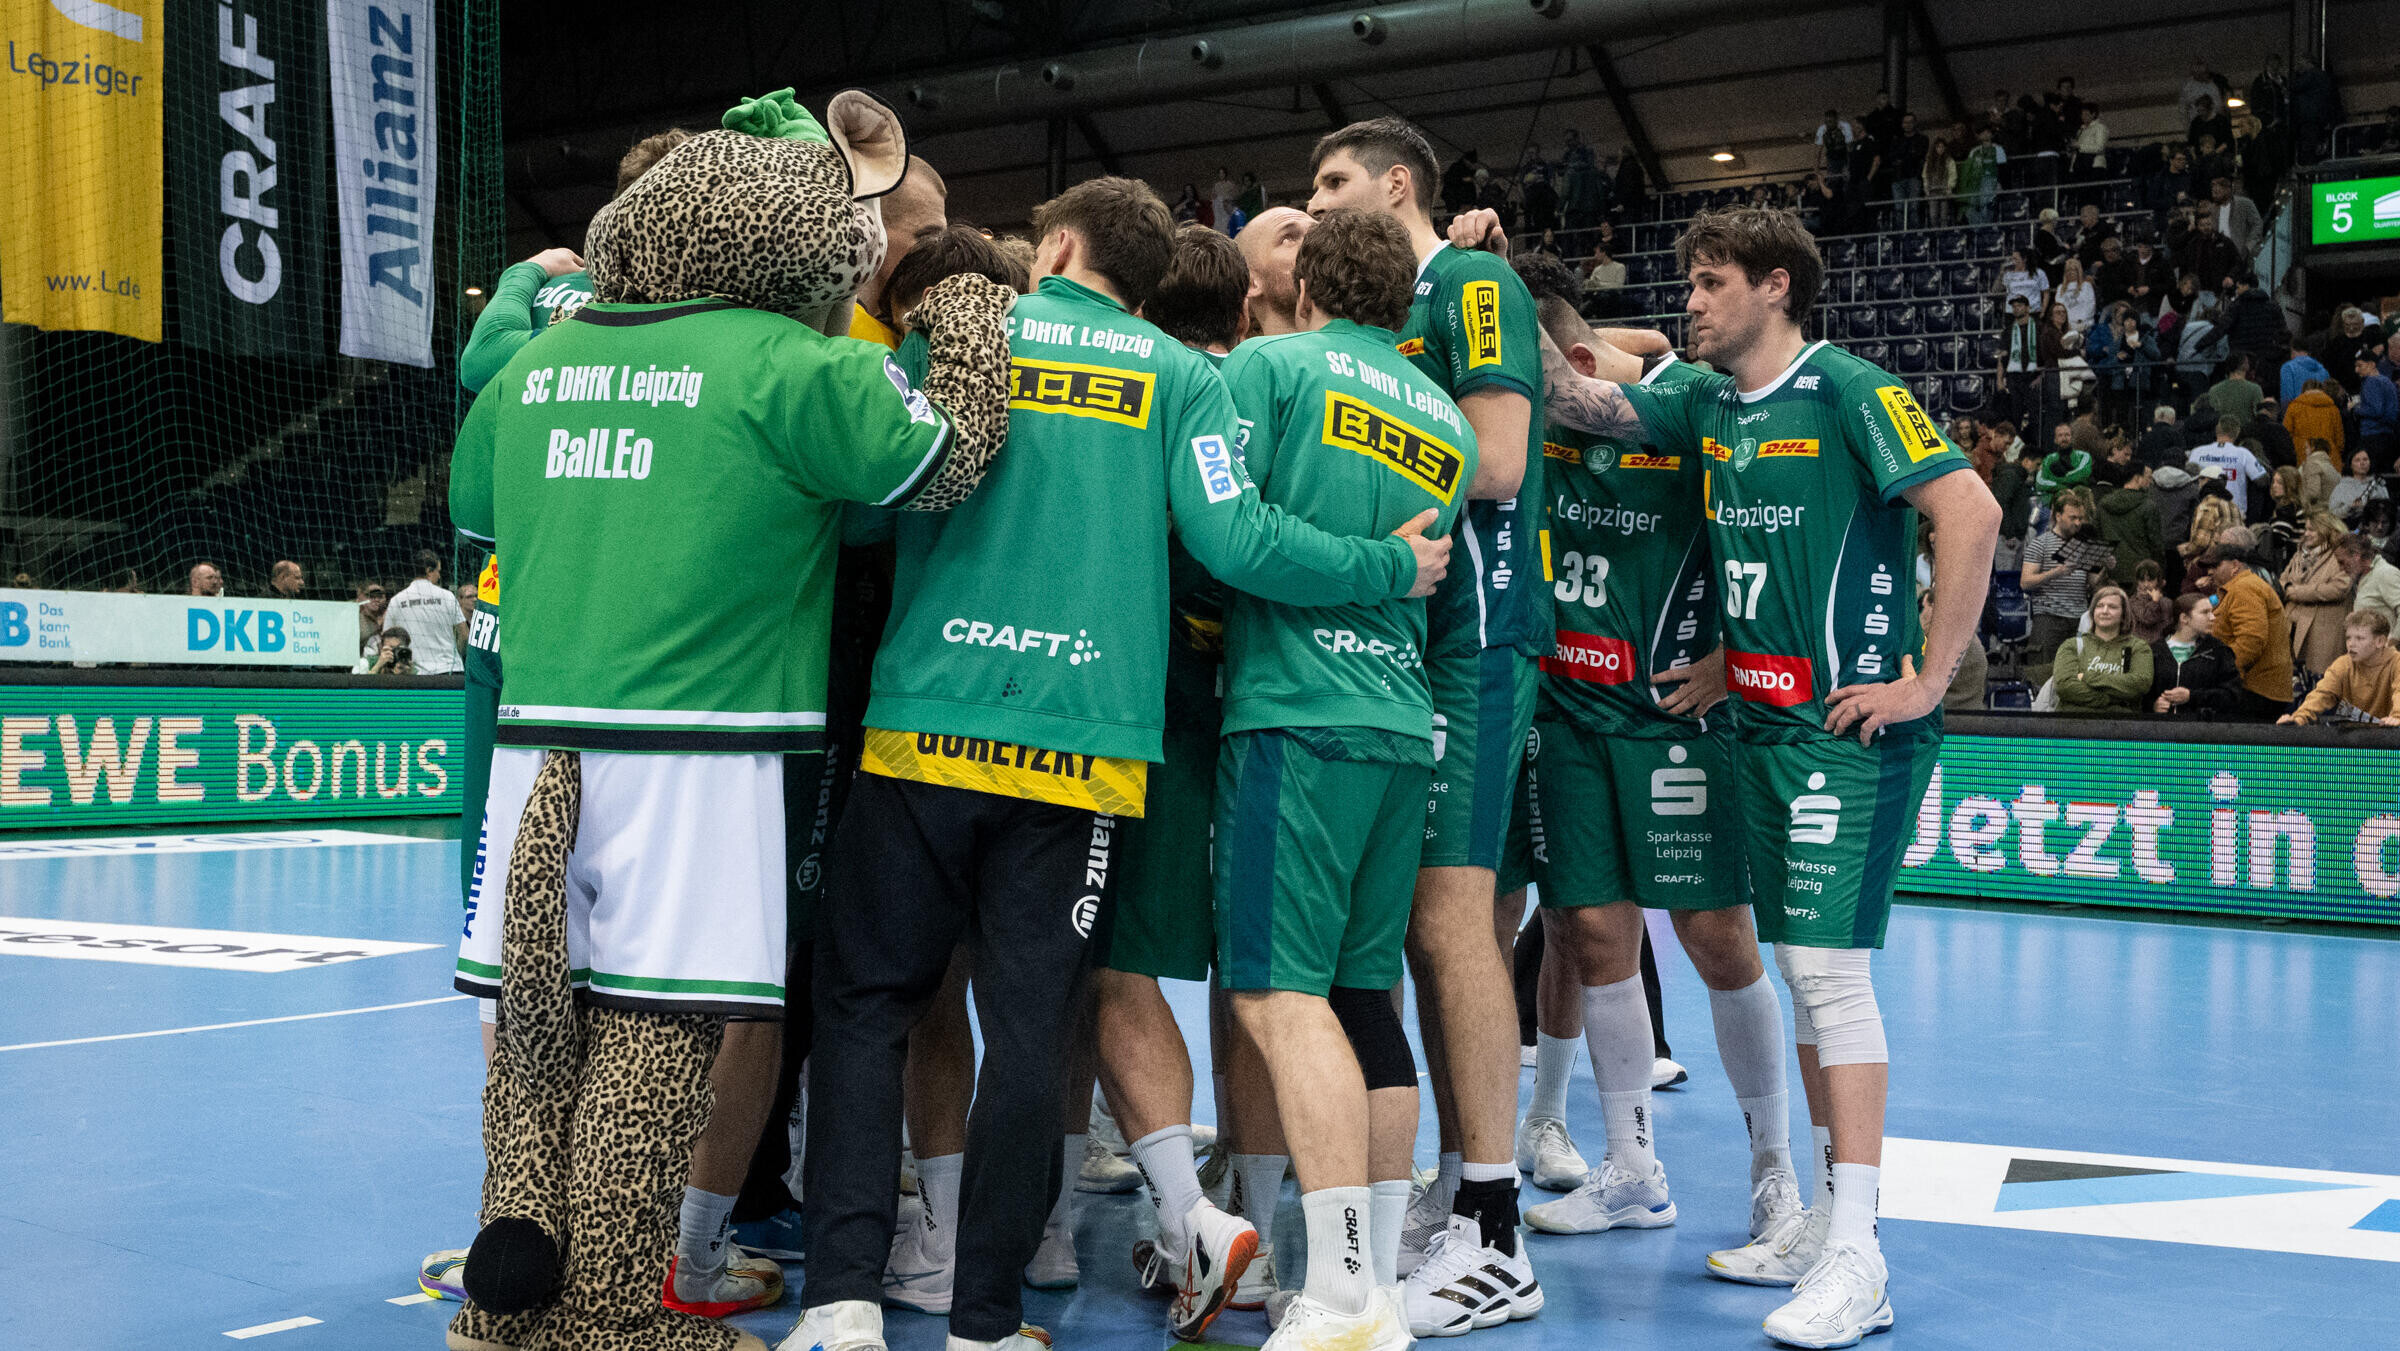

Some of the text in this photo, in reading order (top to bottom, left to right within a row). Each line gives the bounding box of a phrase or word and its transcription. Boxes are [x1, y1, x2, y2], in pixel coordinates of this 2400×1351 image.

[219, 0, 282, 304] CRAF
[363, 5, 424, 308] Allianz
[2326, 191, 2358, 203] BLOCK
[2332, 202, 2353, 233] 5
[1005, 316, 1155, 359] C DHfK Leipzig
[1477, 289, 1496, 356] B.A.S.
[521, 364, 704, 409] SC DHfK Leipzig
[1325, 350, 1462, 437] SC DHfK Leipzig
[1792, 375, 1821, 391] REWE
[1338, 405, 1448, 488] B.A.S.
[1764, 442, 1810, 455] DHL
[1858, 402, 1899, 473] SACHSENLOTTO
[1199, 440, 1232, 495] DKB
[1628, 456, 1673, 467] DHL
[1557, 494, 1662, 536] Leipziger
[1553, 550, 1610, 608] 33
[1724, 559, 1768, 620] 67
[39, 602, 64, 617] Das
[39, 619, 71, 633] kann
[292, 611, 314, 625] Das
[39, 635, 71, 649] Bank
[187, 607, 287, 653] DKB
[292, 626, 320, 640] kann
[942, 617, 1071, 658] CRAFT
[292, 641, 321, 654] Bank
[1553, 643, 1620, 671] RNADO
[1731, 663, 1796, 691] RNADO
[0, 712, 449, 807] EWE Bonus
[1528, 767, 1550, 864] Allianz
[1902, 761, 2177, 885] Jetzt
[2207, 769, 2318, 892] in
[1085, 810, 1116, 890] ianz
[1646, 830, 1713, 845] Sparkasse
[1655, 846, 1703, 861] Leipzig
[1654, 874, 1695, 884] CRAFT
[1784, 857, 1837, 876] arkasse
[1787, 875, 1823, 895] Leipzig
[0, 930, 369, 964] esort
[1634, 1106, 1646, 1134] CRAFT
[1343, 1205, 1360, 1255] CRAFT
